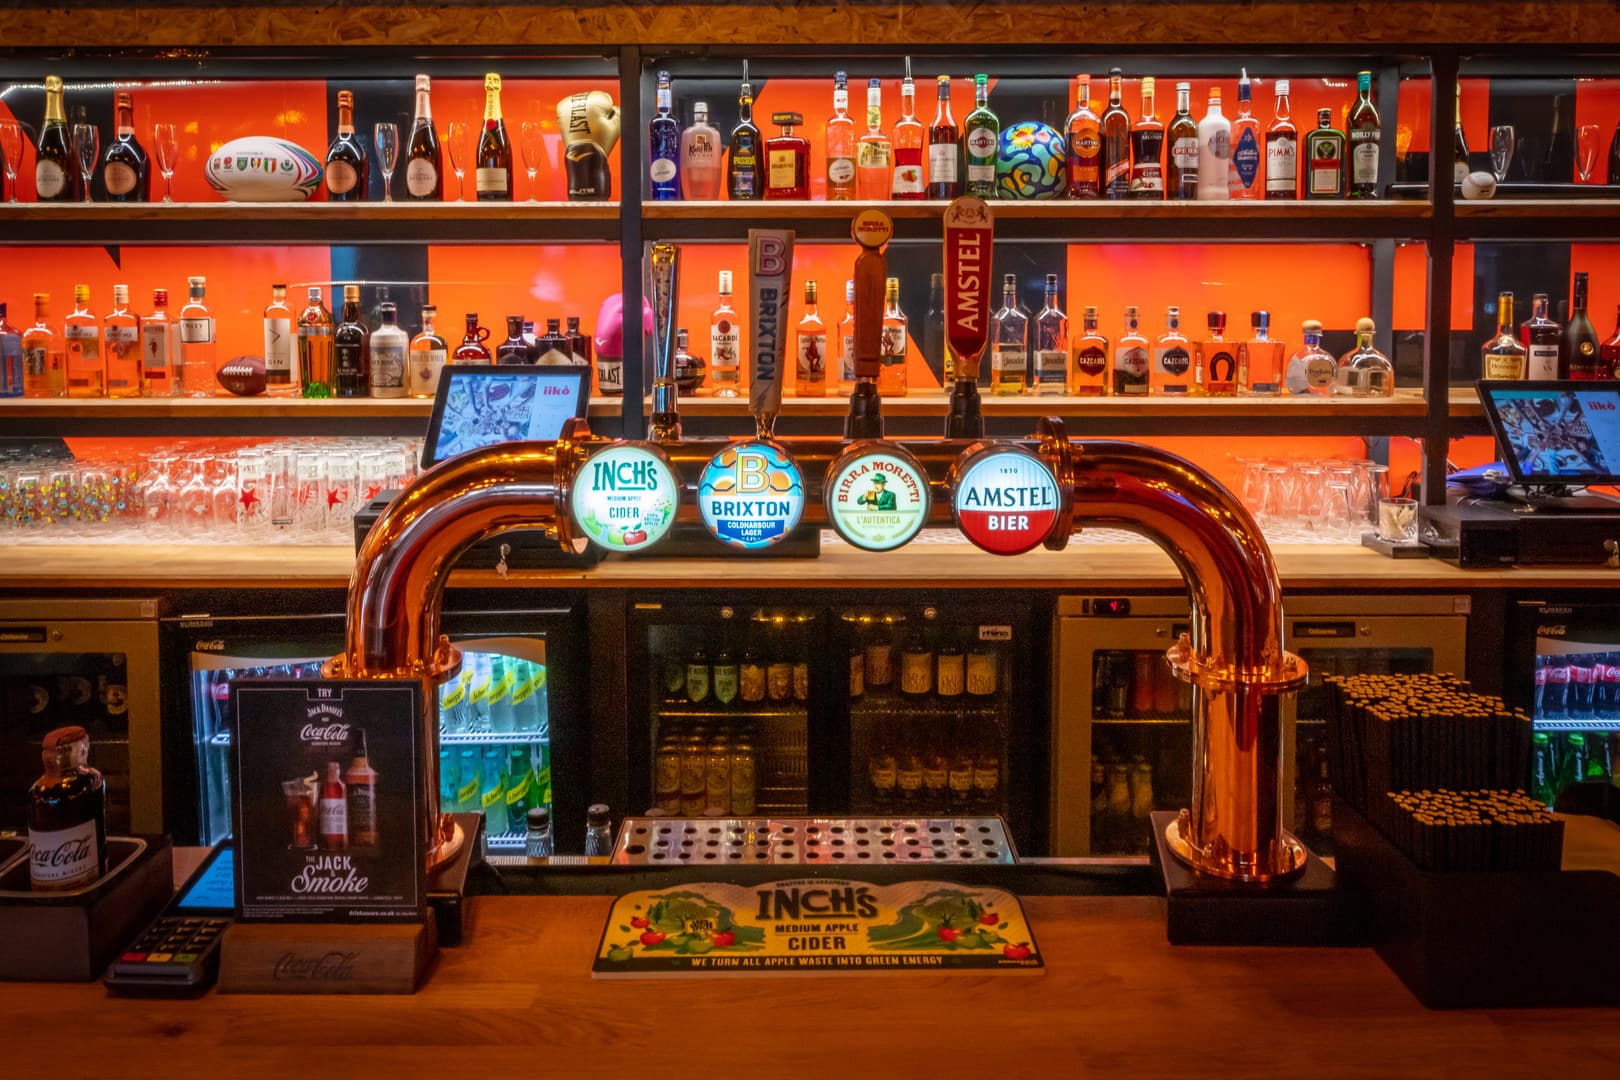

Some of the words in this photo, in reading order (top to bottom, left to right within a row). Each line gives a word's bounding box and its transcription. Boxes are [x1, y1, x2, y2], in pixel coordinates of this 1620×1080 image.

[969, 139, 995, 147] MARTINI
[755, 236, 785, 276] B
[957, 233, 981, 332] AMSTEL
[757, 287, 778, 381] BRIXTON
[592, 459, 658, 491] INCH'S
[736, 452, 770, 493] B
[838, 464, 870, 503] BIRRA
[872, 461, 920, 503] MORETTI
[964, 486, 1053, 507] AMSTEL
[609, 506, 640, 518] CIDER
[711, 500, 791, 517] BRIXTON
[727, 521, 776, 529] COLDHARBOUR
[856, 515, 901, 525] L'AUTENTICA
[988, 515, 1029, 531] BIER
[741, 529, 763, 537] LAGER
[318, 688, 332, 698] TRY
[300, 723, 351, 741] Coca-Cola
[316, 855, 351, 870] JACK
[291, 865, 368, 893] Smoke
[755, 884, 878, 921] INCH'S
[775, 924, 821, 933] MEDIUM
[825, 923, 859, 932] APPLE
[788, 936, 846, 950] CIDER
[691, 957, 707, 966] WE
[712, 957, 739, 966] TURN
[743, 957, 761, 966] ALL
[765, 957, 794, 966] APPLE
[799, 957, 834, 966] WASTE
[837, 956, 862, 965] INTO
[866, 956, 899, 965] GREEN
[903, 956, 943, 965] ENERGY
